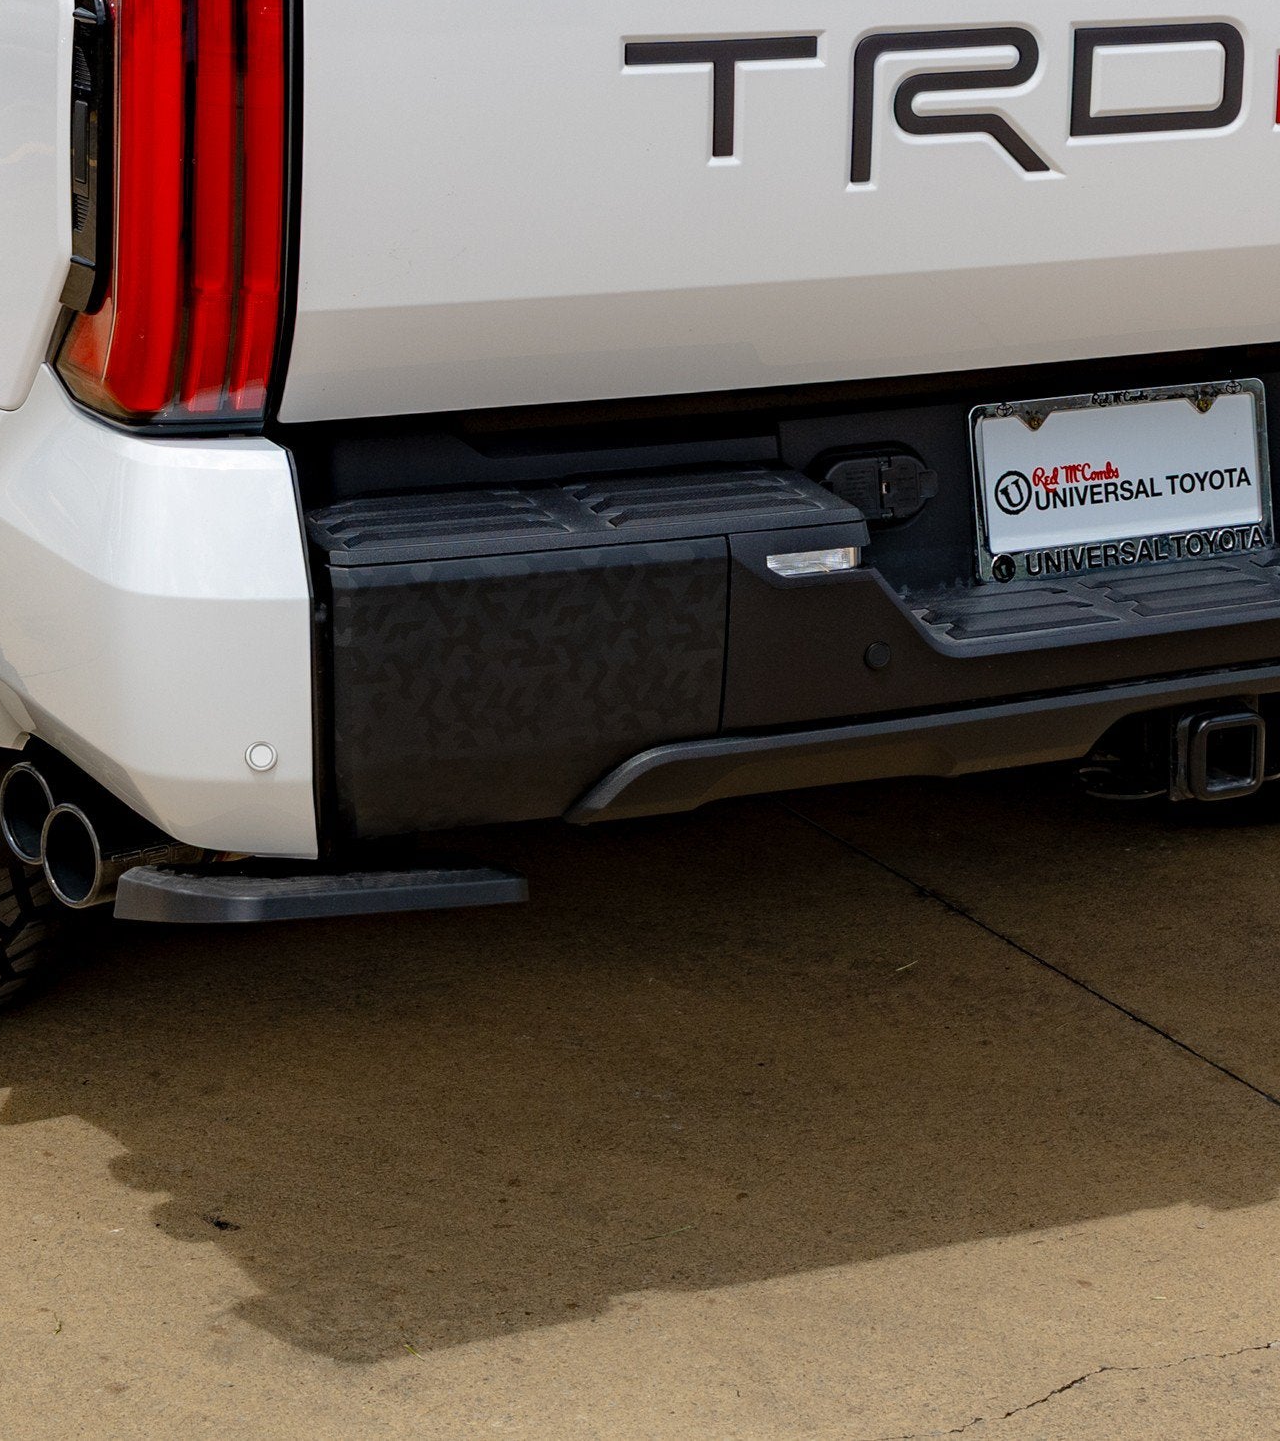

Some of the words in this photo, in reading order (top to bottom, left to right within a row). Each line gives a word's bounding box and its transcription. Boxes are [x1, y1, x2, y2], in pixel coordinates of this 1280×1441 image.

[623, 21, 1247, 185] TRD
[1032, 467, 1059, 493] Red
[1060, 461, 1120, 484] McCombs
[1035, 477, 1163, 511] UNIVERSAL
[1165, 466, 1252, 495] TOYOTA
[1024, 538, 1169, 577] UNIVERSAL
[1169, 525, 1267, 558] TOYOTA
